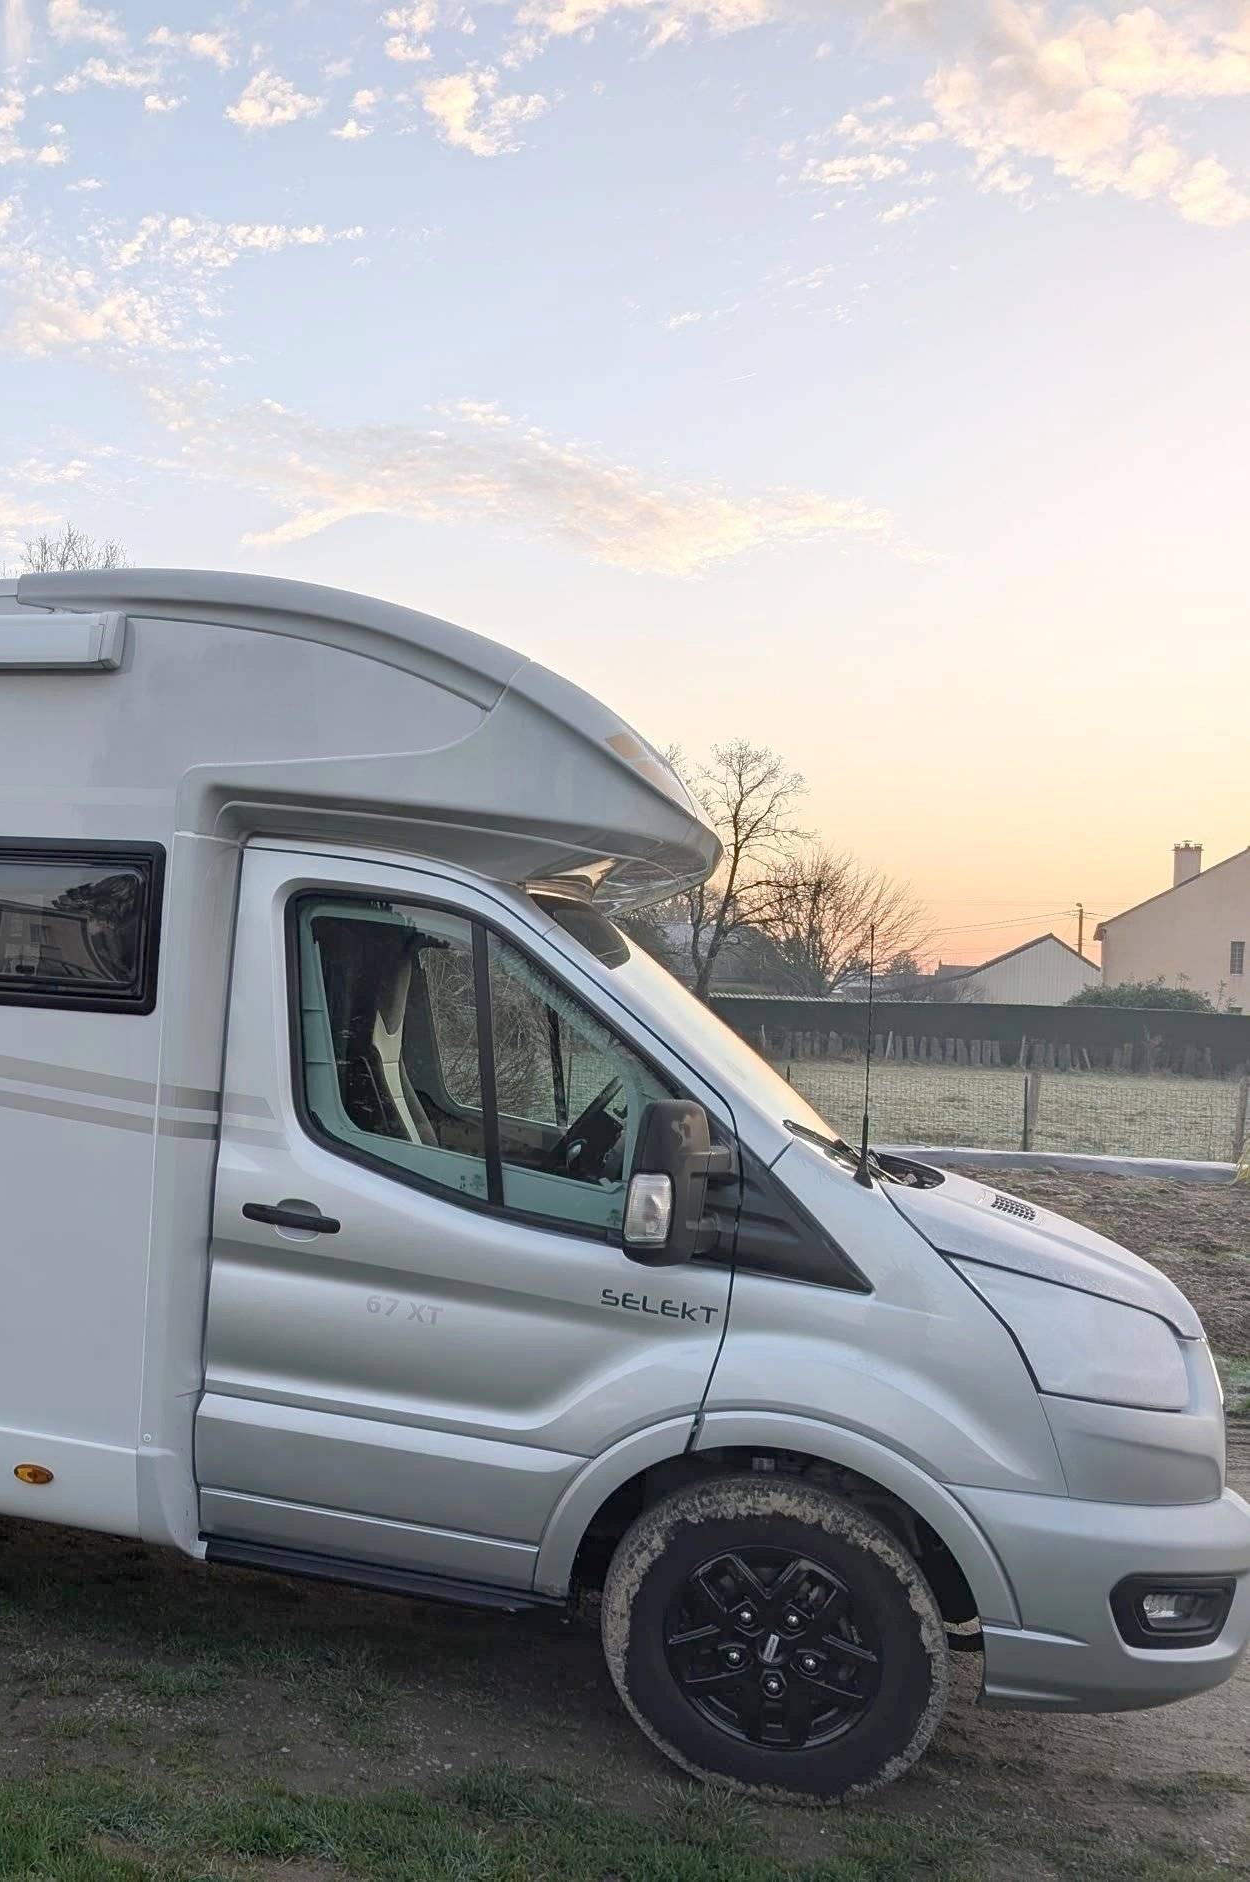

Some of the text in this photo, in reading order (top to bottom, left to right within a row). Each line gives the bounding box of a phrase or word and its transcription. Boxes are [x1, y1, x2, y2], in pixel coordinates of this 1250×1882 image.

[366, 1295, 444, 1325] 67 XT
[600, 1288, 719, 1324] SELEKT
